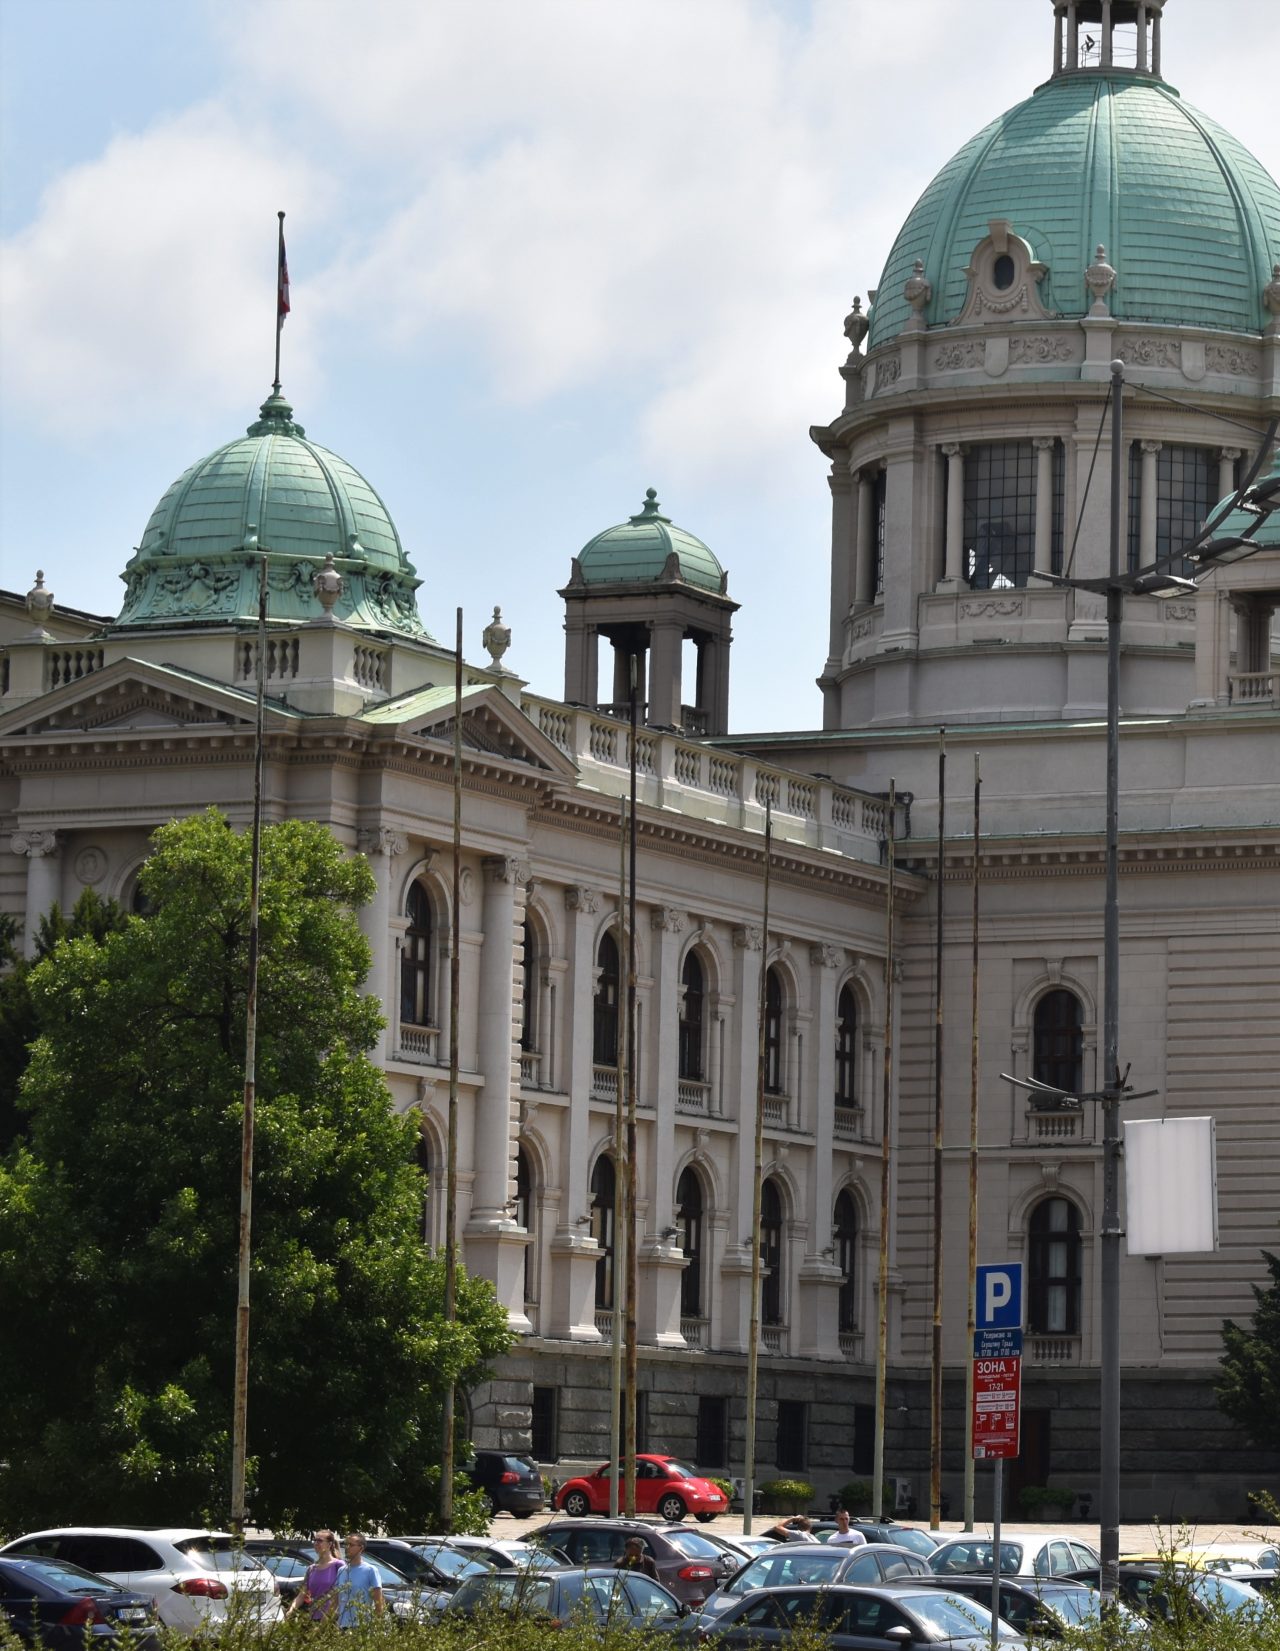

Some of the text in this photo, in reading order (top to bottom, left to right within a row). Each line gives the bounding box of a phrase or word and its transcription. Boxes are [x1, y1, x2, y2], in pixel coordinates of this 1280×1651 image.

[985, 1272, 1011, 1322] P
[977, 1360, 1017, 1374] ЗОНА 1
[988, 1383, 1004, 1391] 17-21
